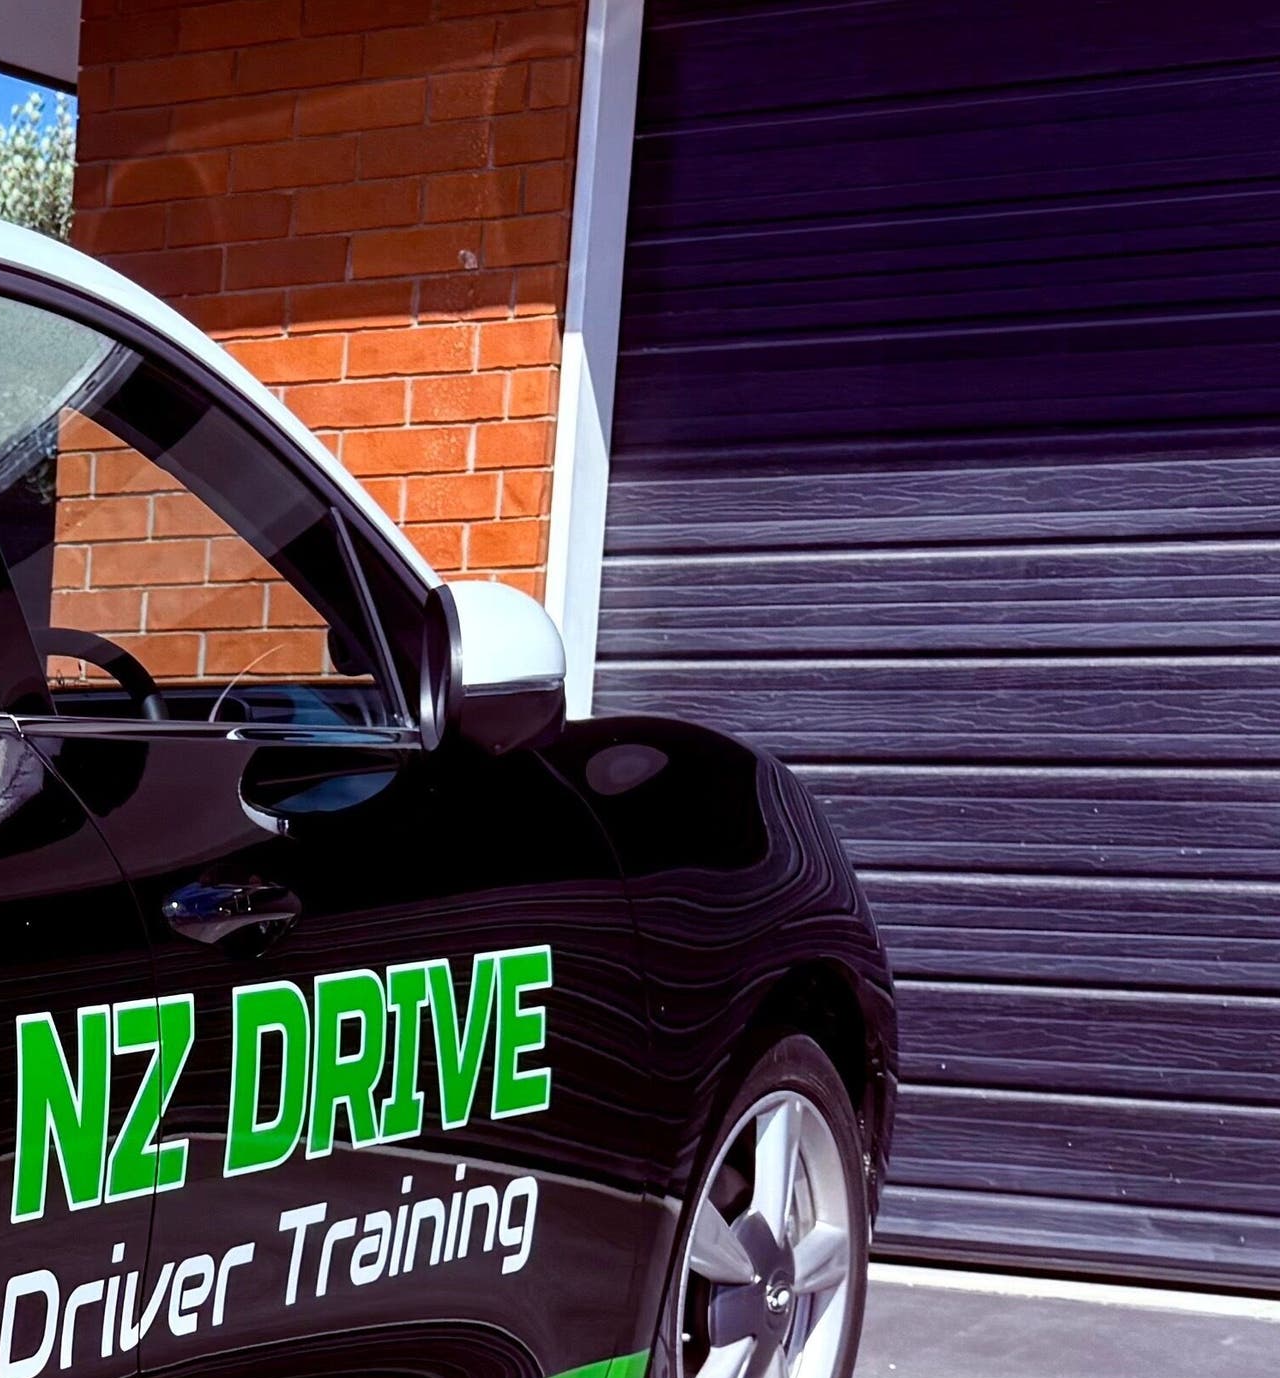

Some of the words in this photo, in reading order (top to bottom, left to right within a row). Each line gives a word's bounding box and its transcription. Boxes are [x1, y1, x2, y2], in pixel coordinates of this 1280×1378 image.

[11, 993, 195, 1224] NZ
[222, 944, 553, 1178] DRIVE
[278, 1163, 539, 1306] Training
